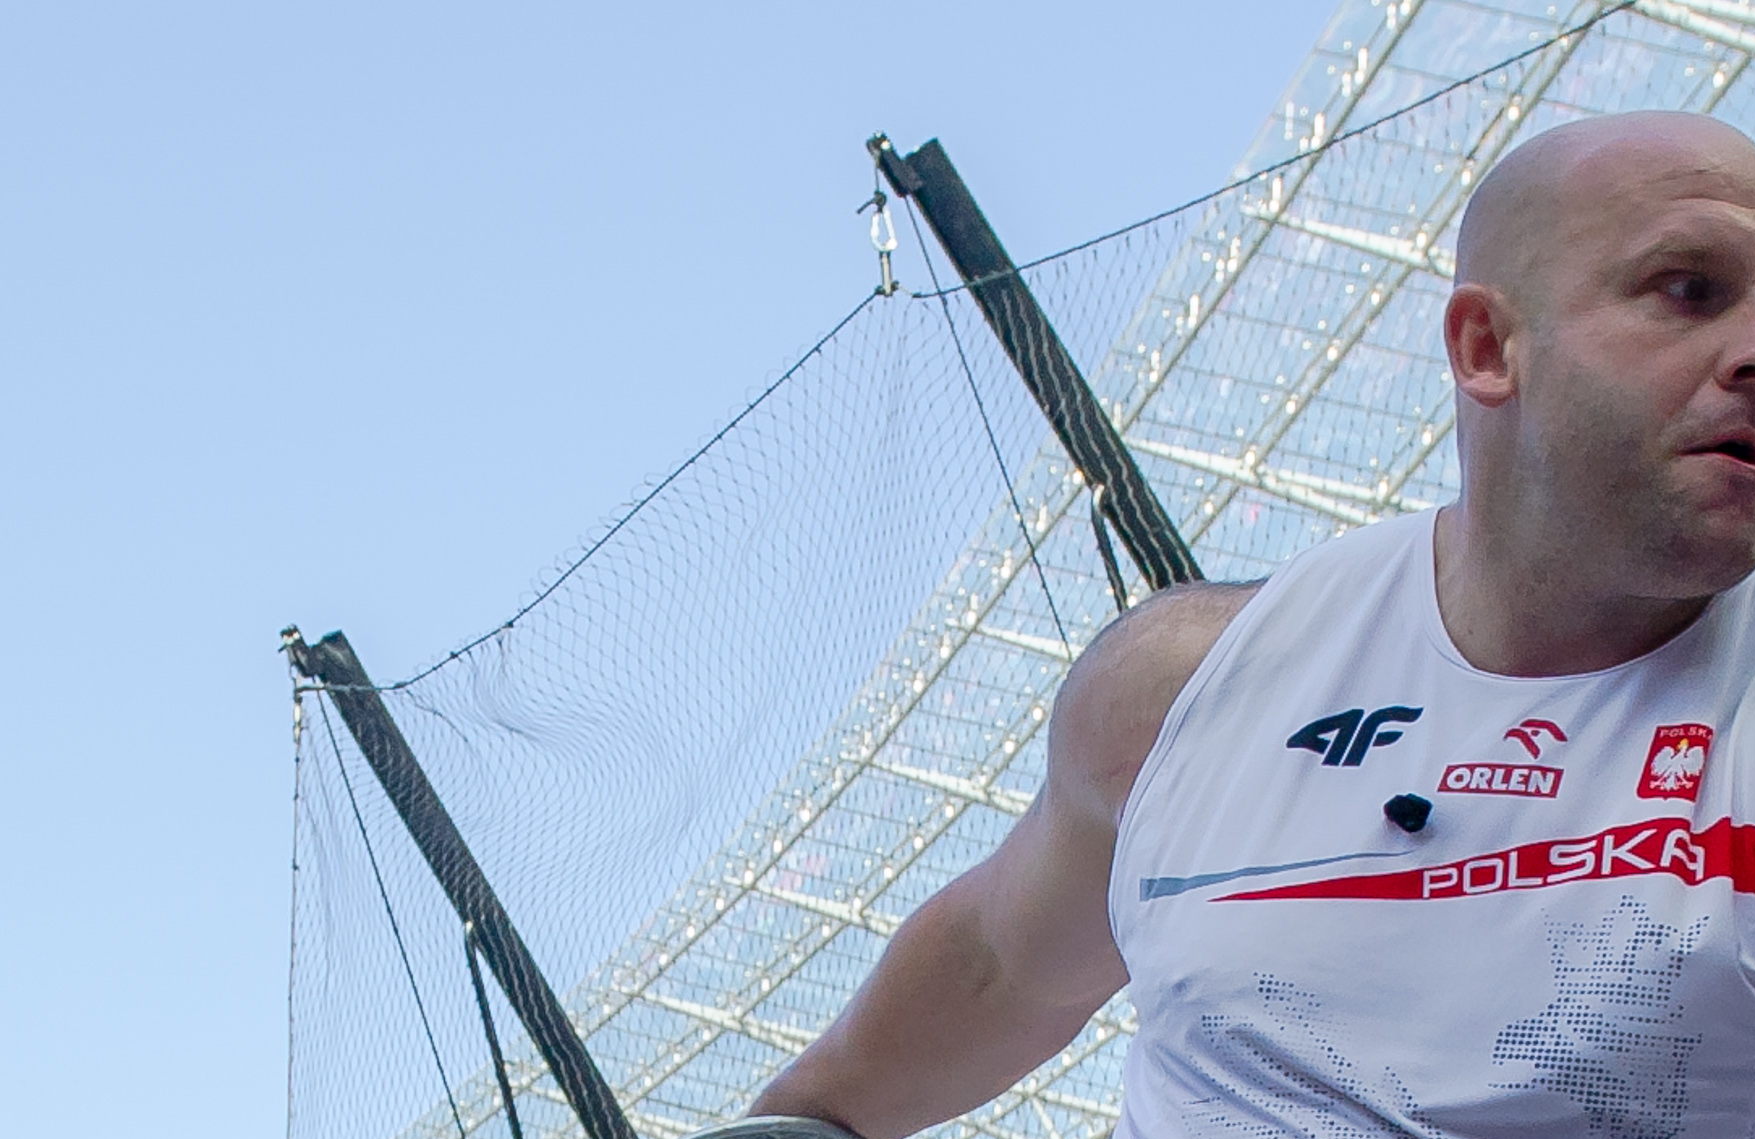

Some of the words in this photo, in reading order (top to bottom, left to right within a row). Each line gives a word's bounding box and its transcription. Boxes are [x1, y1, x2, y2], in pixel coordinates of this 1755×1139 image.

[1286, 705, 1424, 768] 4F
[1445, 767, 1557, 795] ORLEN
[1422, 827, 1705, 900] POLSKA
